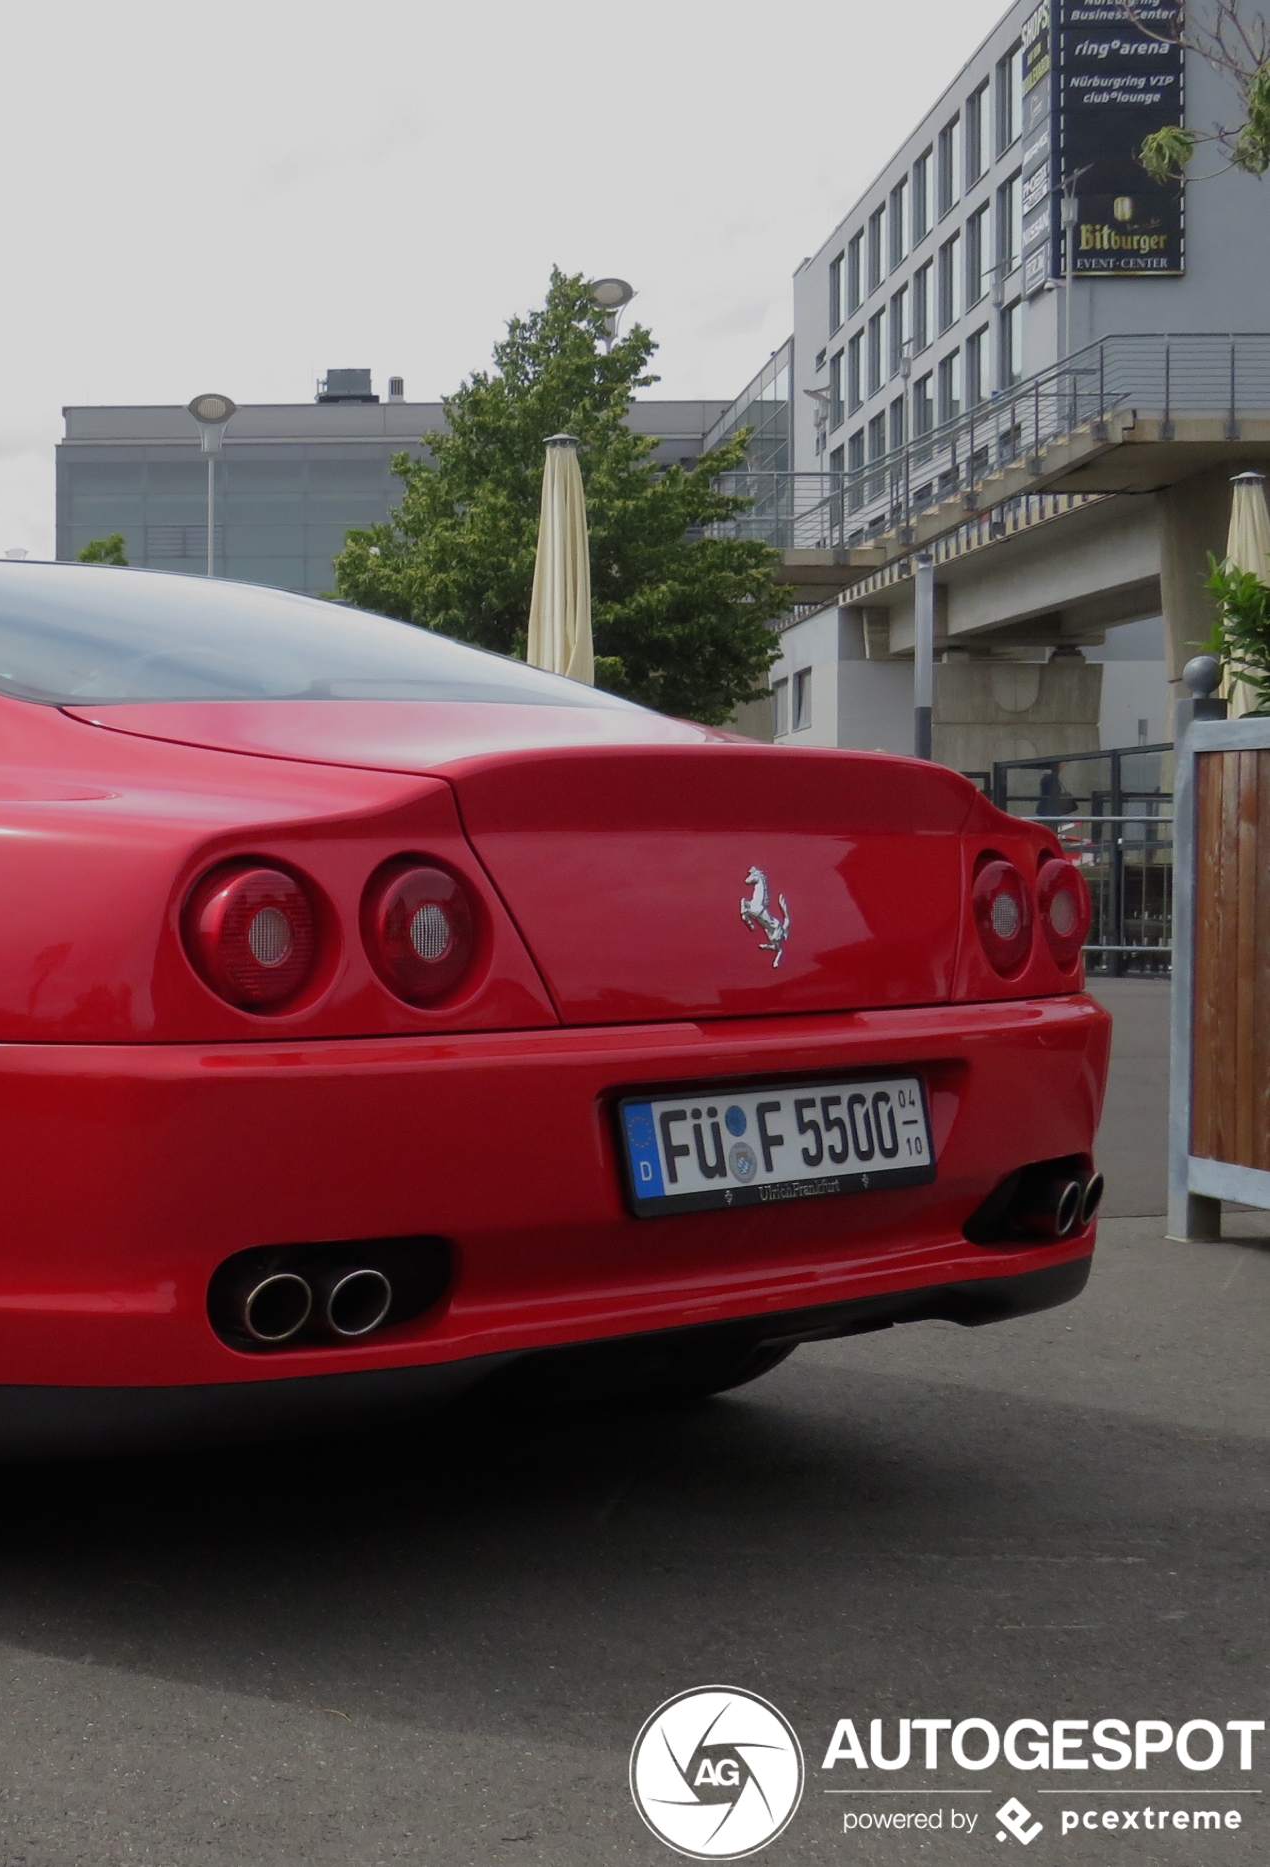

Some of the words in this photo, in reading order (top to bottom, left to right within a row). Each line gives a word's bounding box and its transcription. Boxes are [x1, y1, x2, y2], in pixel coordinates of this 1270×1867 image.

[1070, 9, 1129, 21] Business
[1069, 73, 1148, 91] Nürburgring
[1150, 75, 1174, 87] VIP
[1022, 209, 1049, 248] NISSAN
[1079, 223, 1168, 254] Bitburger
[898, 1088, 917, 1108] 04
[794, 1091, 899, 1168] 5500
[905, 1136, 924, 1156] 10
[639, 1160, 653, 1182] D
